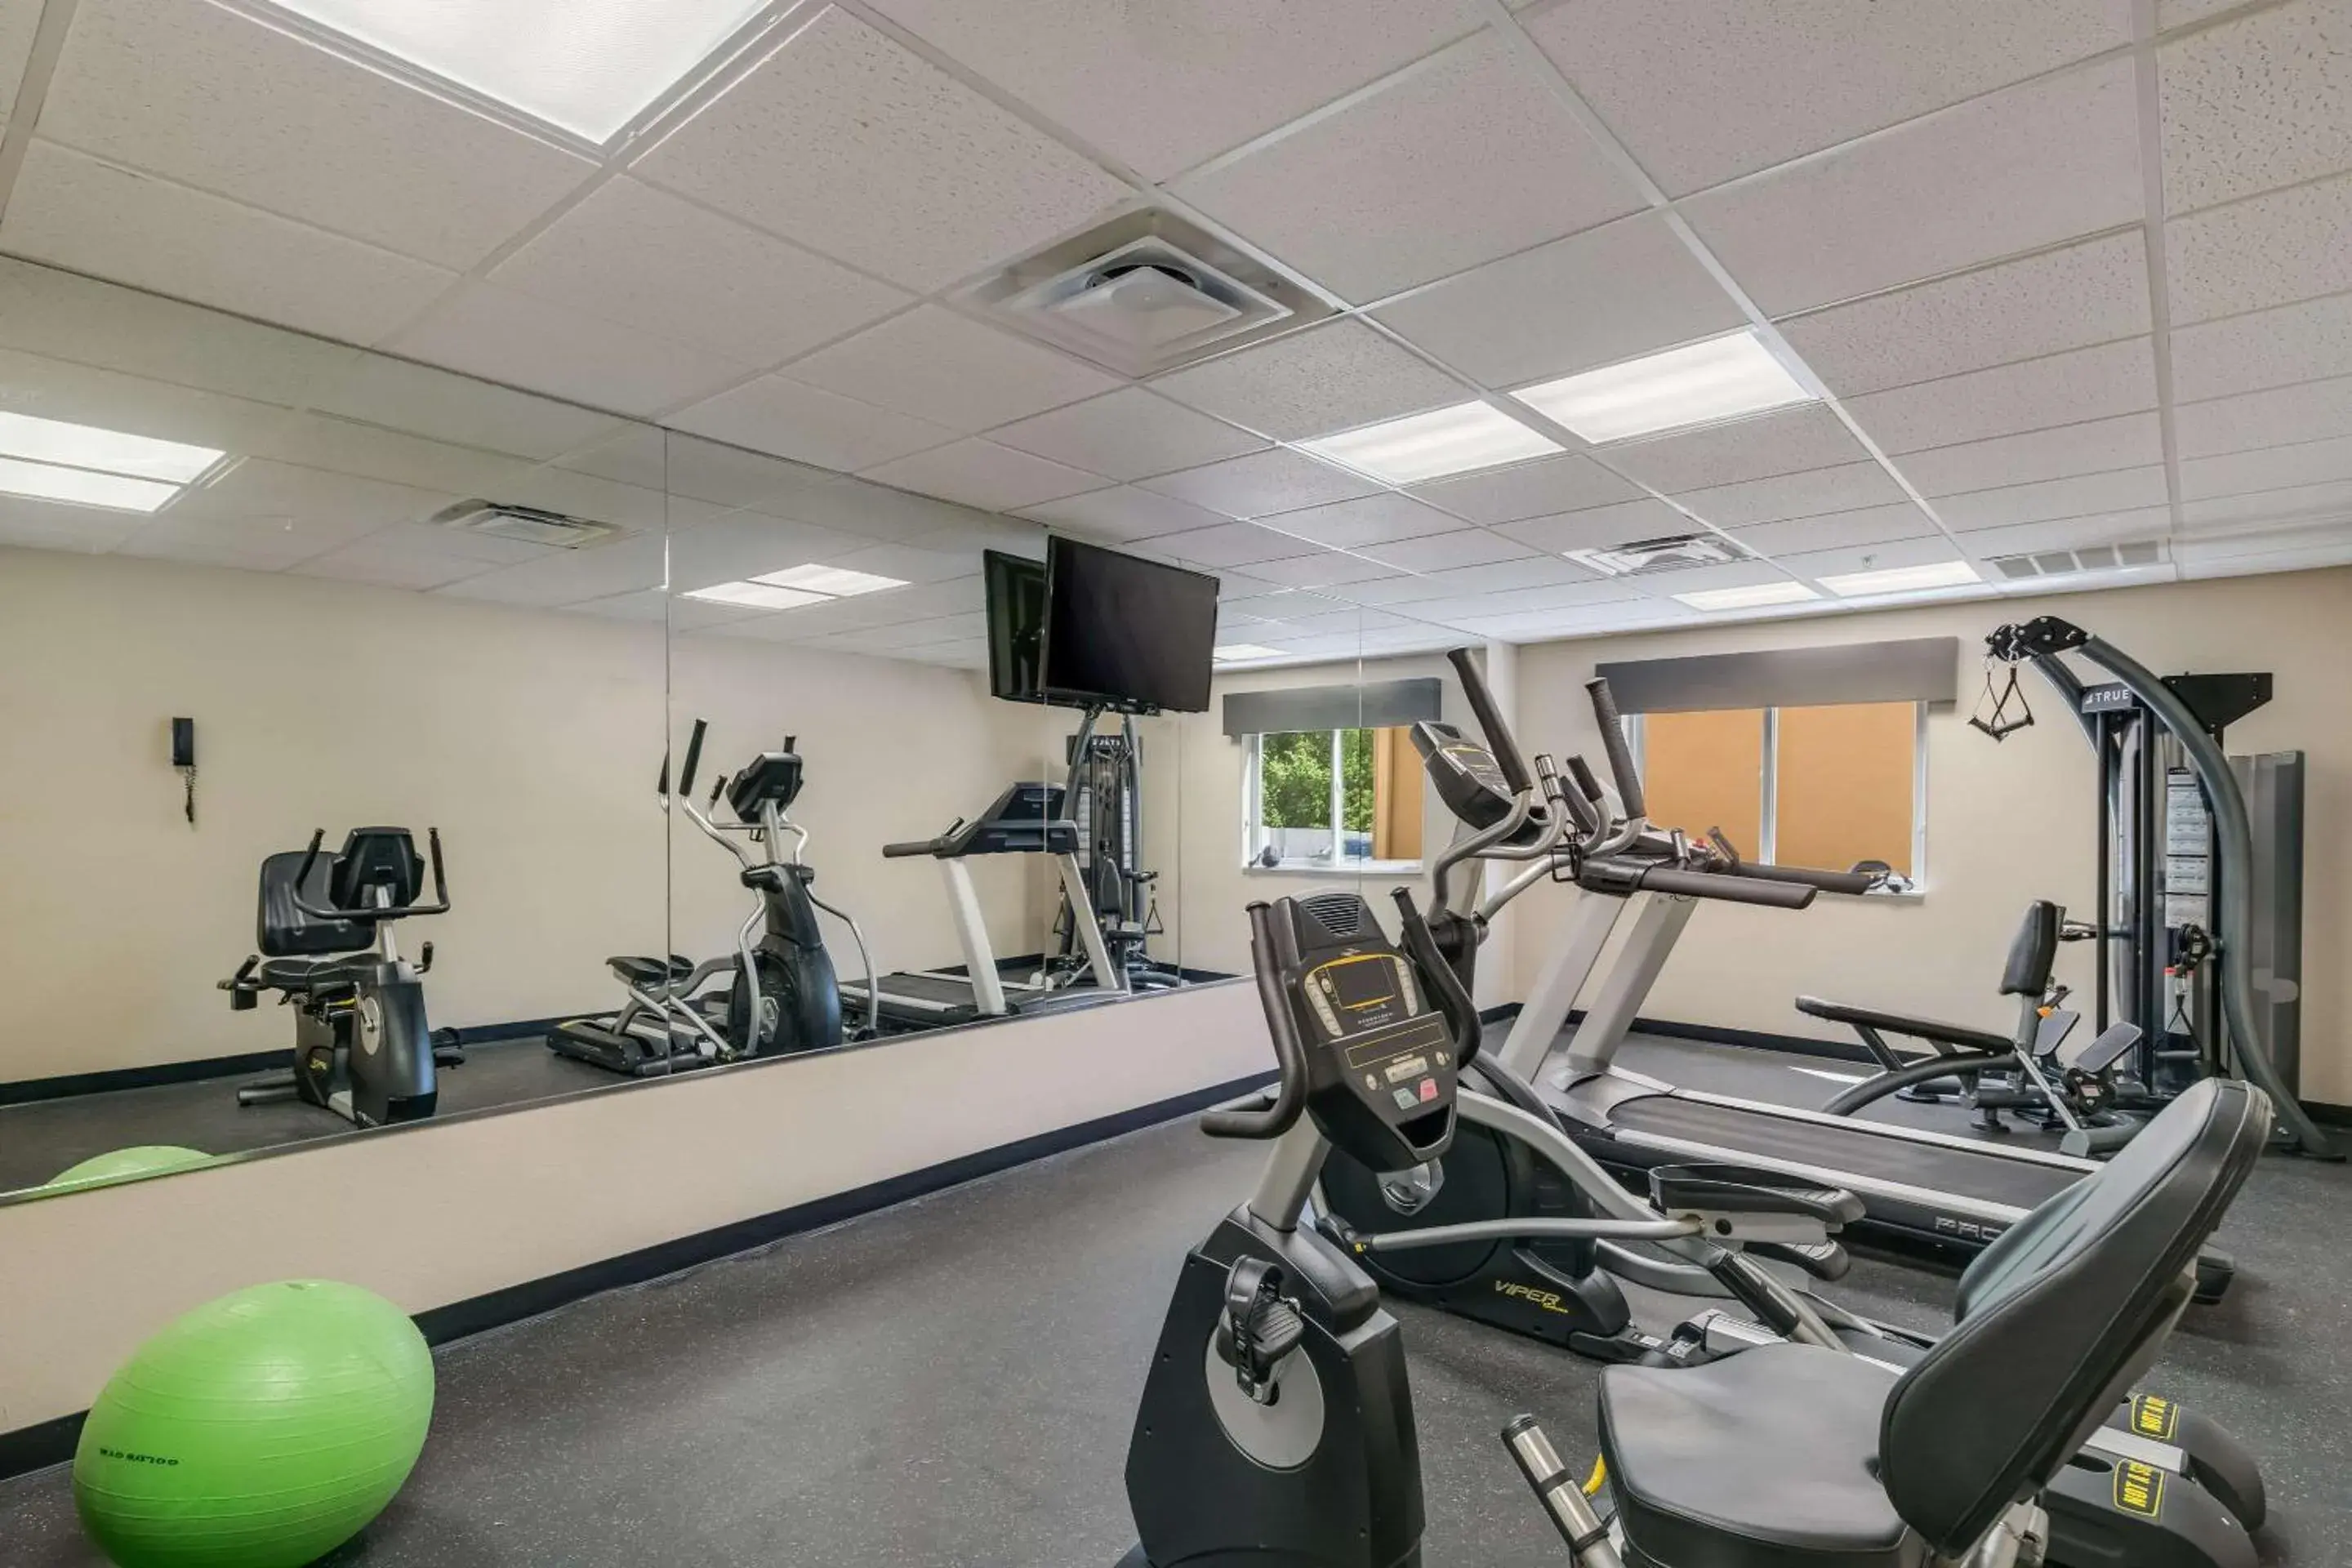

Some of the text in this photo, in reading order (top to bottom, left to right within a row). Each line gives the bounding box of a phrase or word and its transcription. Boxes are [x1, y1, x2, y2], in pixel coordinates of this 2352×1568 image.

[2095, 689, 2129, 702] TRUE
[1495, 1280, 1561, 1306] VIPER
[2123, 1481, 2149, 1508] NOT
